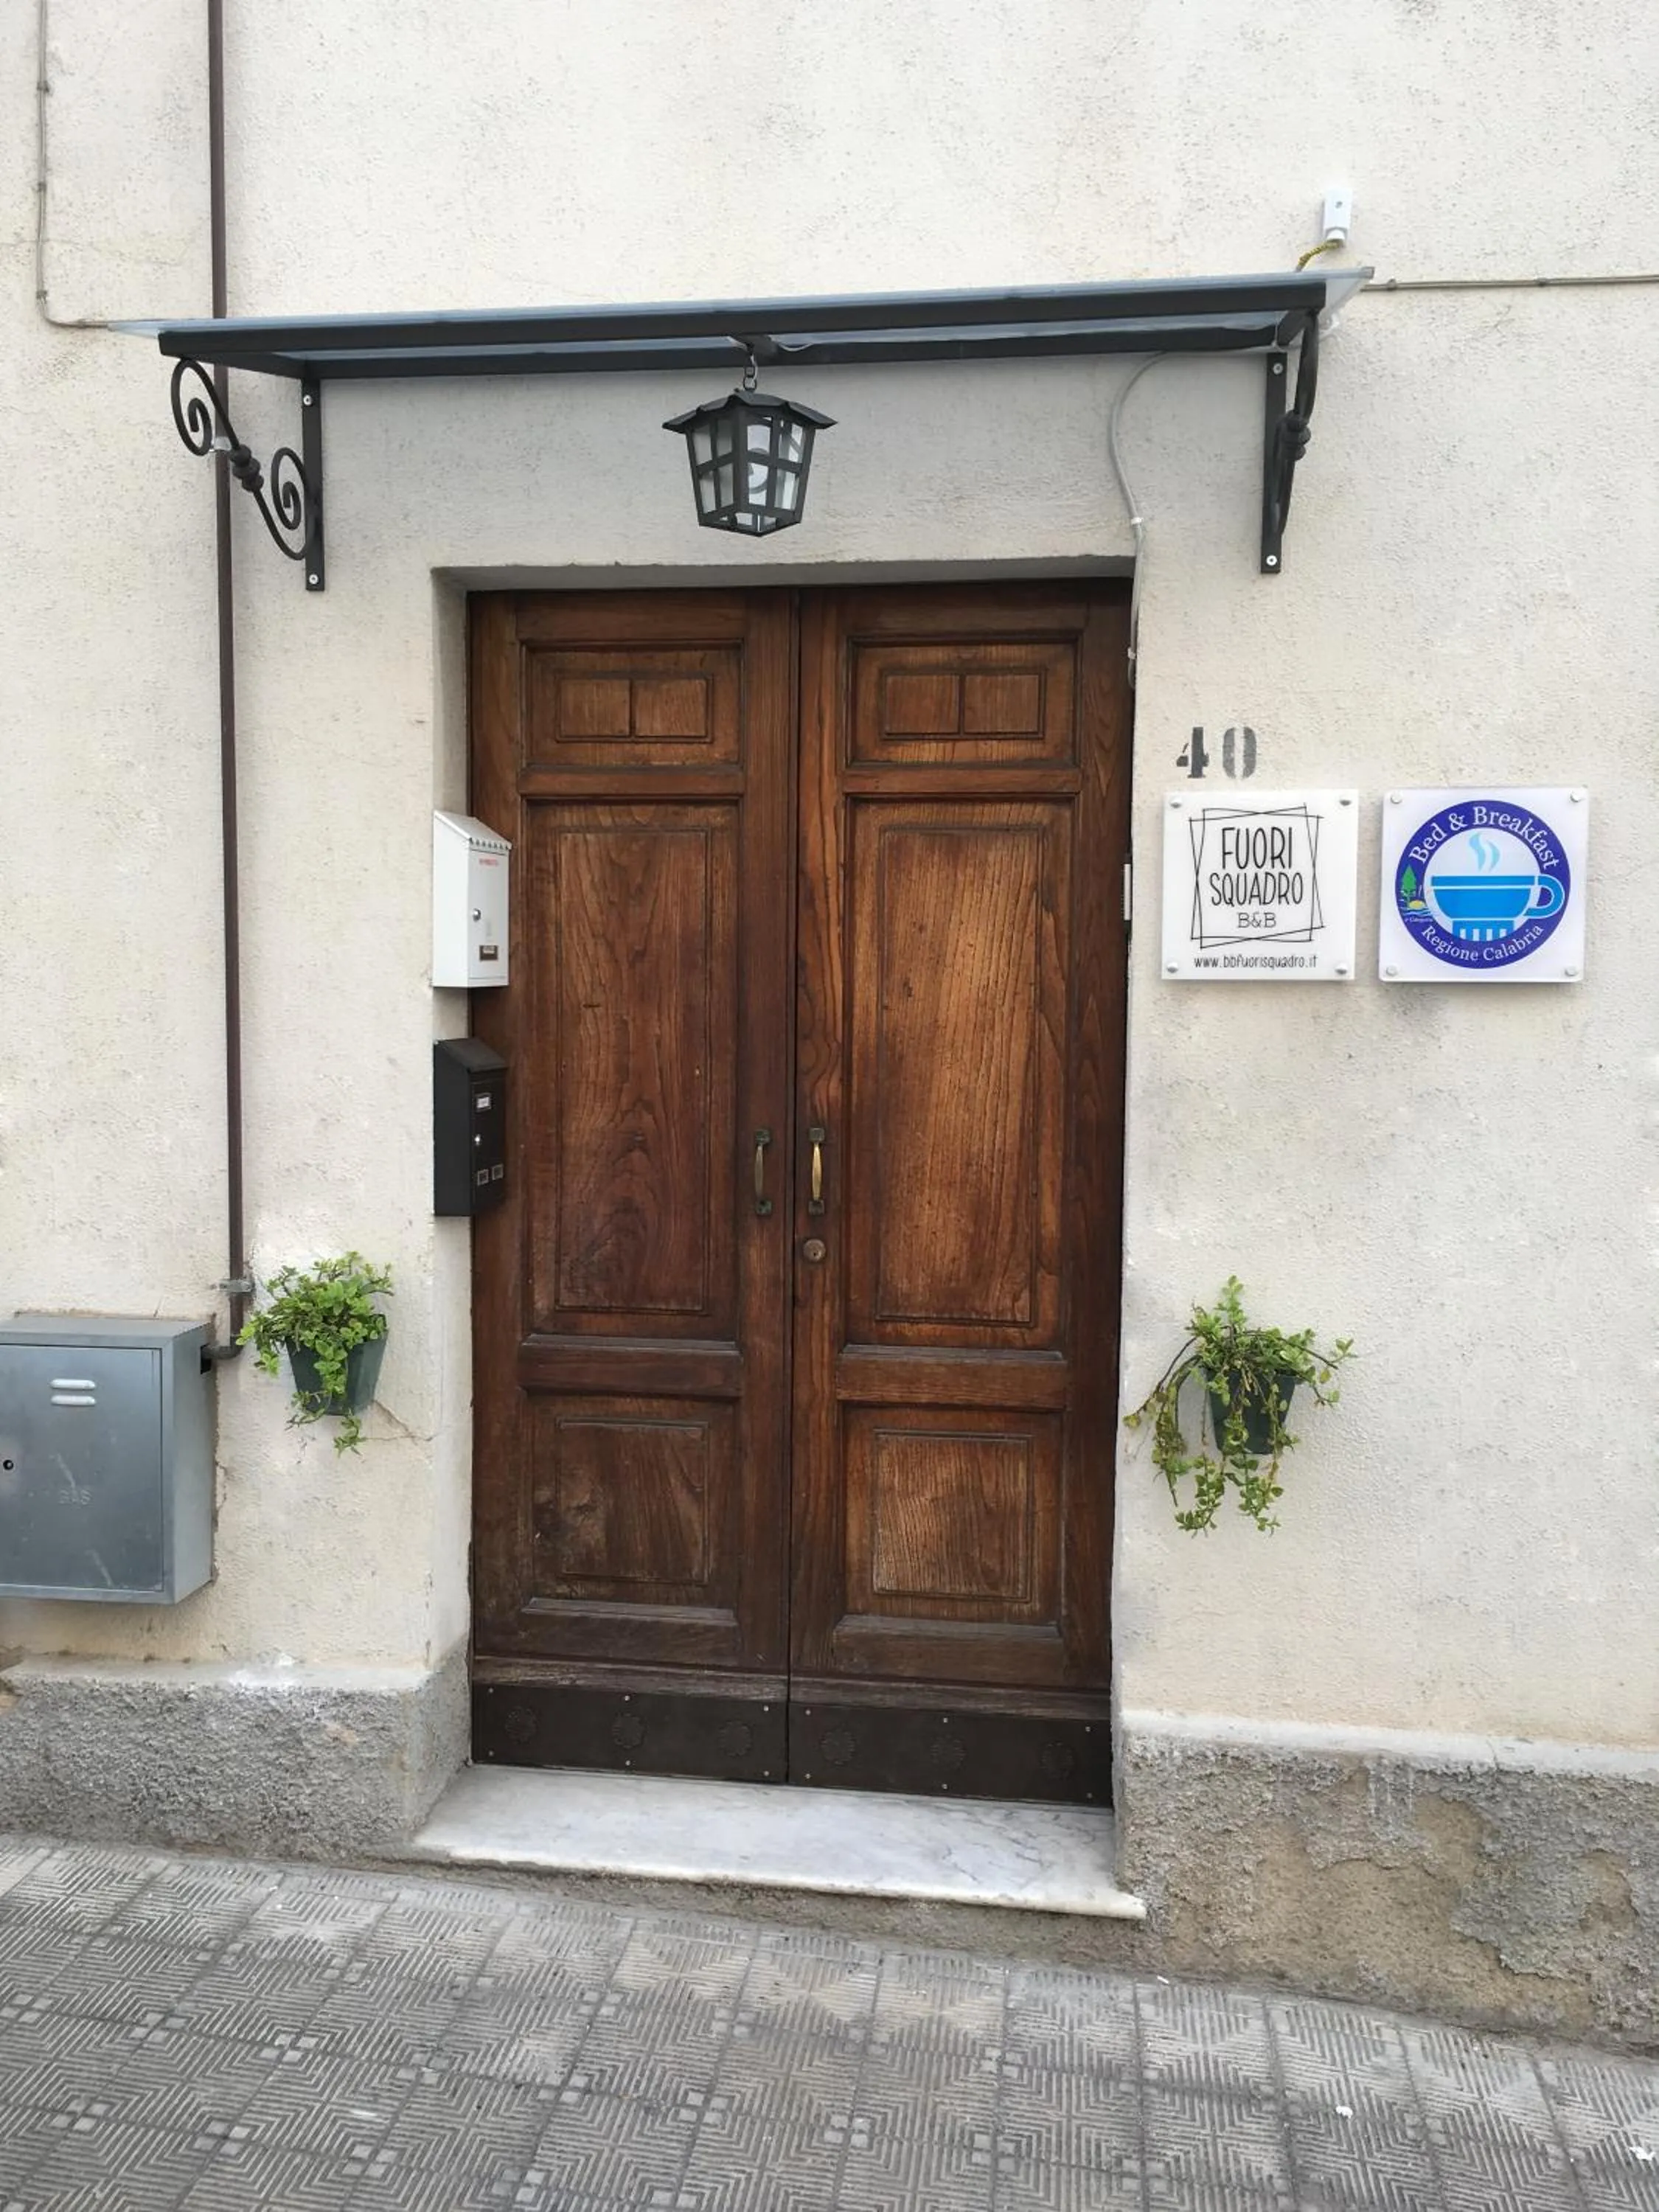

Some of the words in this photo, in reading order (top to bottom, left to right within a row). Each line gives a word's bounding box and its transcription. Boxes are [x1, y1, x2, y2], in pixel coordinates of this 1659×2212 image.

[1176, 726, 1257, 779] 40
[1221, 826, 1293, 870] FUORI
[1409, 823, 1447, 864] Bed
[1448, 813, 1468, 831] &
[1472, 806, 1559, 871] Breakfast
[1208, 871, 1304, 908] SQUADRO
[1237, 911, 1277, 929] B&B
[1422, 925, 1479, 961] Regione
[1483, 925, 1545, 961] Calabria
[1194, 954, 1318, 970] www.bbfuorisquadro.it
